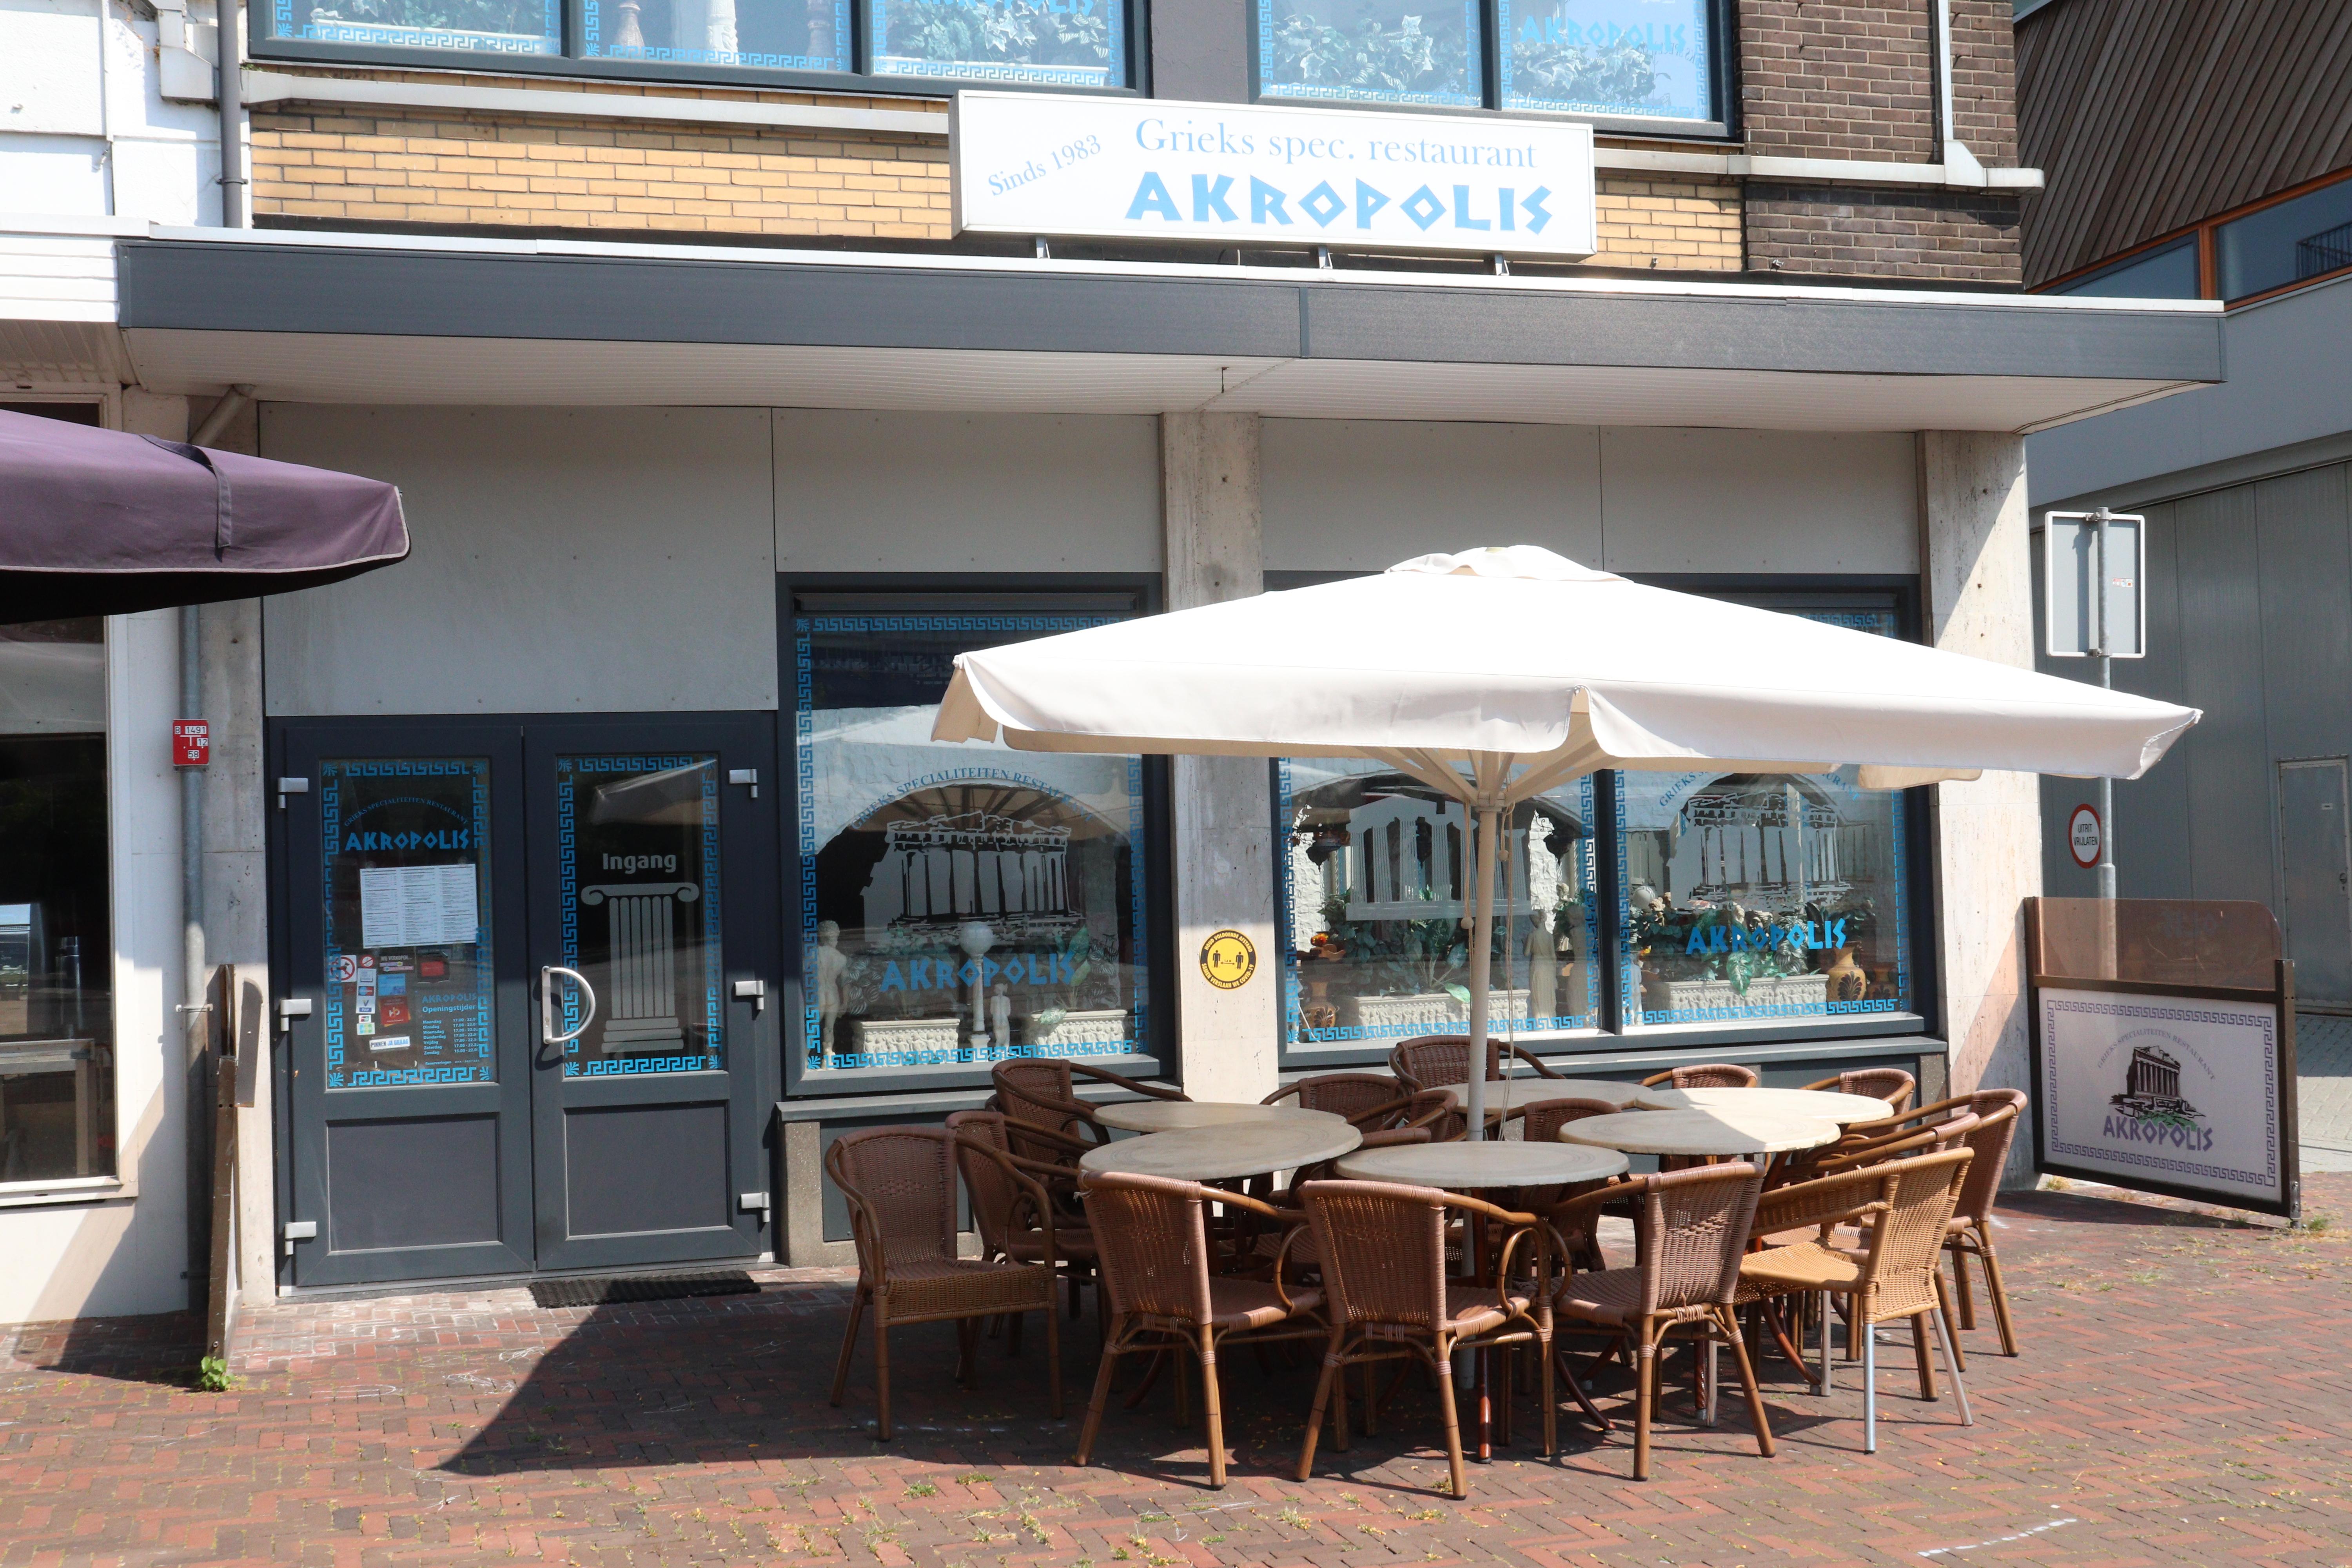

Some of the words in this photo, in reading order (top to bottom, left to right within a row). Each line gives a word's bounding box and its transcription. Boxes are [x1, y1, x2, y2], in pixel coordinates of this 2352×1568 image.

[1519, 15, 1686, 53] AKROPOLIS
[1136, 118, 1254, 155] Grieks
[1269, 135, 1354, 164] spec.
[1368, 138, 1538, 168] restaurant
[988, 160, 1046, 196] Sinds
[1051, 134, 1101, 170] 1983
[1125, 172, 1553, 235] AKROPOLIS
[851, 791, 896, 829] GRIEKS
[897, 768, 1009, 794] SPECIALITEITEN
[1659, 771, 1696, 807] GRIEKS
[1822, 773, 1860, 802] URANT
[344, 809, 367, 826] GRIEKS
[367, 797, 425, 810] SPECIALITEITEN
[426, 799, 469, 824] RESTAURANT
[2078, 824, 2092, 833] UITRIT
[345, 828, 469, 851] AKROPOLIS
[2074, 836, 2098, 846] VRIJLATEN
[603, 853, 676, 874] Ingang
[1204, 938, 1214, 951] HOUD
[1238, 936, 1253, 953] AFSTAND
[1686, 918, 1846, 955] AKROPOLIS
[880, 950, 1076, 992] AKROPOLIS
[1201, 963, 1212, 979] SAMEN
[1210, 977, 1232, 988] VERSLAAN
[1239, 964, 1254, 984] COVID-19
[422, 993, 477, 1003] AKROPOLIS
[423, 1004, 476, 1014] Openingstijder
[2098, 1044, 2117, 1069] GRIEKS
[2117, 1028, 2171, 1045] SPECIALITEITEN
[2172, 1035, 2215, 1080] RESTAURANT
[2103, 1115, 2213, 1152] AKROPOLIS
